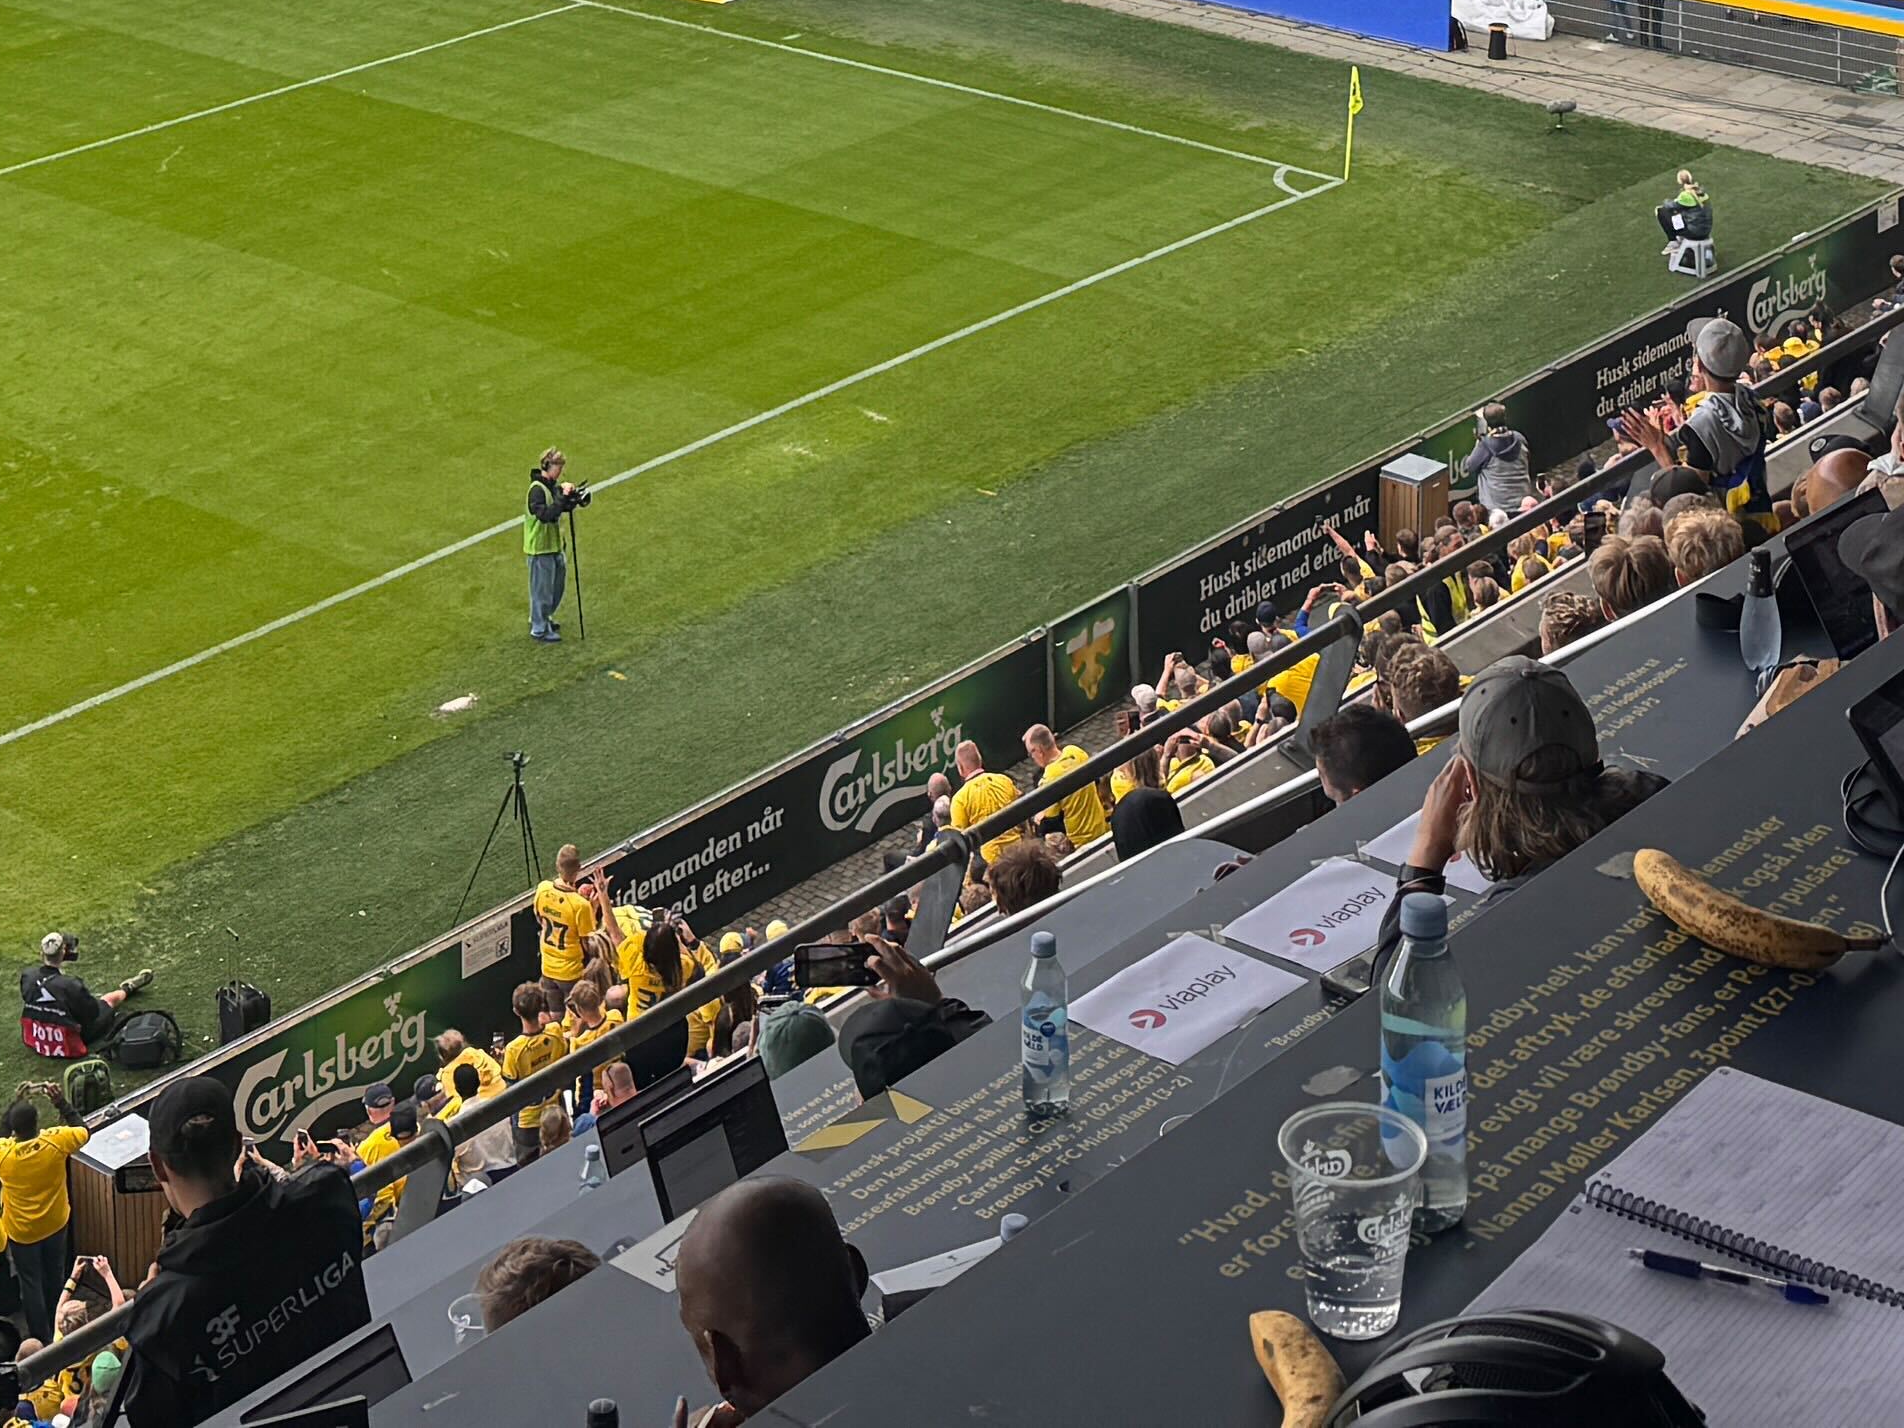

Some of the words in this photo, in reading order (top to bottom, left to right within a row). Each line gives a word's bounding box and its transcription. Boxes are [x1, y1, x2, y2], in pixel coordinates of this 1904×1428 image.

[1746, 267, 1827, 334] Carlsberg
[1596, 355, 1631, 390] Husk
[1632, 330, 1693, 368] sideman
[1596, 396, 1616, 419] du
[1617, 376, 1658, 408] dribler
[1660, 363, 1684, 387] ned
[1199, 559, 1242, 603] Husk
[1343, 494, 1373, 532] når
[1199, 606, 1222, 634] du
[1224, 576, 1280, 622] dribler
[1281, 554, 1311, 591] ned
[819, 723, 963, 832] Carlsberg
[614, 829, 743, 907] idemanden
[746, 806, 786, 847] når
[671, 887, 698, 921] ed
[701, 859, 771, 905] efter...
[542, 919, 569, 951] 27
[1316, 885, 1388, 930] viaplay
[1465, 954, 1593, 1054] øndby-helt,
[1583, 931, 1624, 969] kan
[1618, 902, 1662, 947] vari
[1698, 815, 1786, 880] ennesker
[1158, 963, 1237, 1011] viaplay
[1471, 1052, 1519, 1091] det
[1509, 1004, 1592, 1064] aftryk,
[1578, 981, 1614, 1014] de
[1741, 850, 1796, 890] også.
[1782, 822, 1834, 856] Men
[1478, 1086, 1545, 1134] evigt
[1532, 1064, 1571, 1092] vil
[1560, 1027, 1623, 1070] være
[1612, 972, 1698, 1032] skrevet
[1780, 852, 1852, 908] pulsåre
[32, 1022, 64, 1042] FOTO
[233, 1010, 428, 1145] Carlsberg
[1094, 1053, 1150, 1095] Nørgaar
[1472, 1160, 1513, 1194] på
[1502, 1107, 1585, 1167] mange
[1566, 997, 1728, 1111] Brøndby-fans,
[1713, 977, 1742, 1005] er
[833, 1153, 889, 1190] svensk
[886, 1109, 951, 1157] projektil
[944, 1088, 987, 1117] bliver
[849, 1179, 883, 1201] Den
[883, 1162, 916, 1188] kan
[912, 1145, 944, 1170] han
[942, 1119, 977, 1148] ikke
[952, 1133, 991, 1164] med
[975, 1173, 1045, 1221] Brøndby
[1038, 1145, 1084, 1188] IF-FC
[1080, 1096, 1158, 1162] Midtjylland
[1152, 1074, 1195, 1111] (3-2)
[1468, 1177, 1556, 1242] Nanna
[1539, 1125, 1621, 1186] Møller
[1605, 1066, 1706, 1132] Karlsen,
[1688, 1009, 1770, 1067] 3point
[956, 1172, 1013, 1209] Carsten
[1219, 1256, 1246, 1279] er
[206, 1303, 241, 1345] 3F
[217, 1250, 356, 1370] SUPERLIGA
